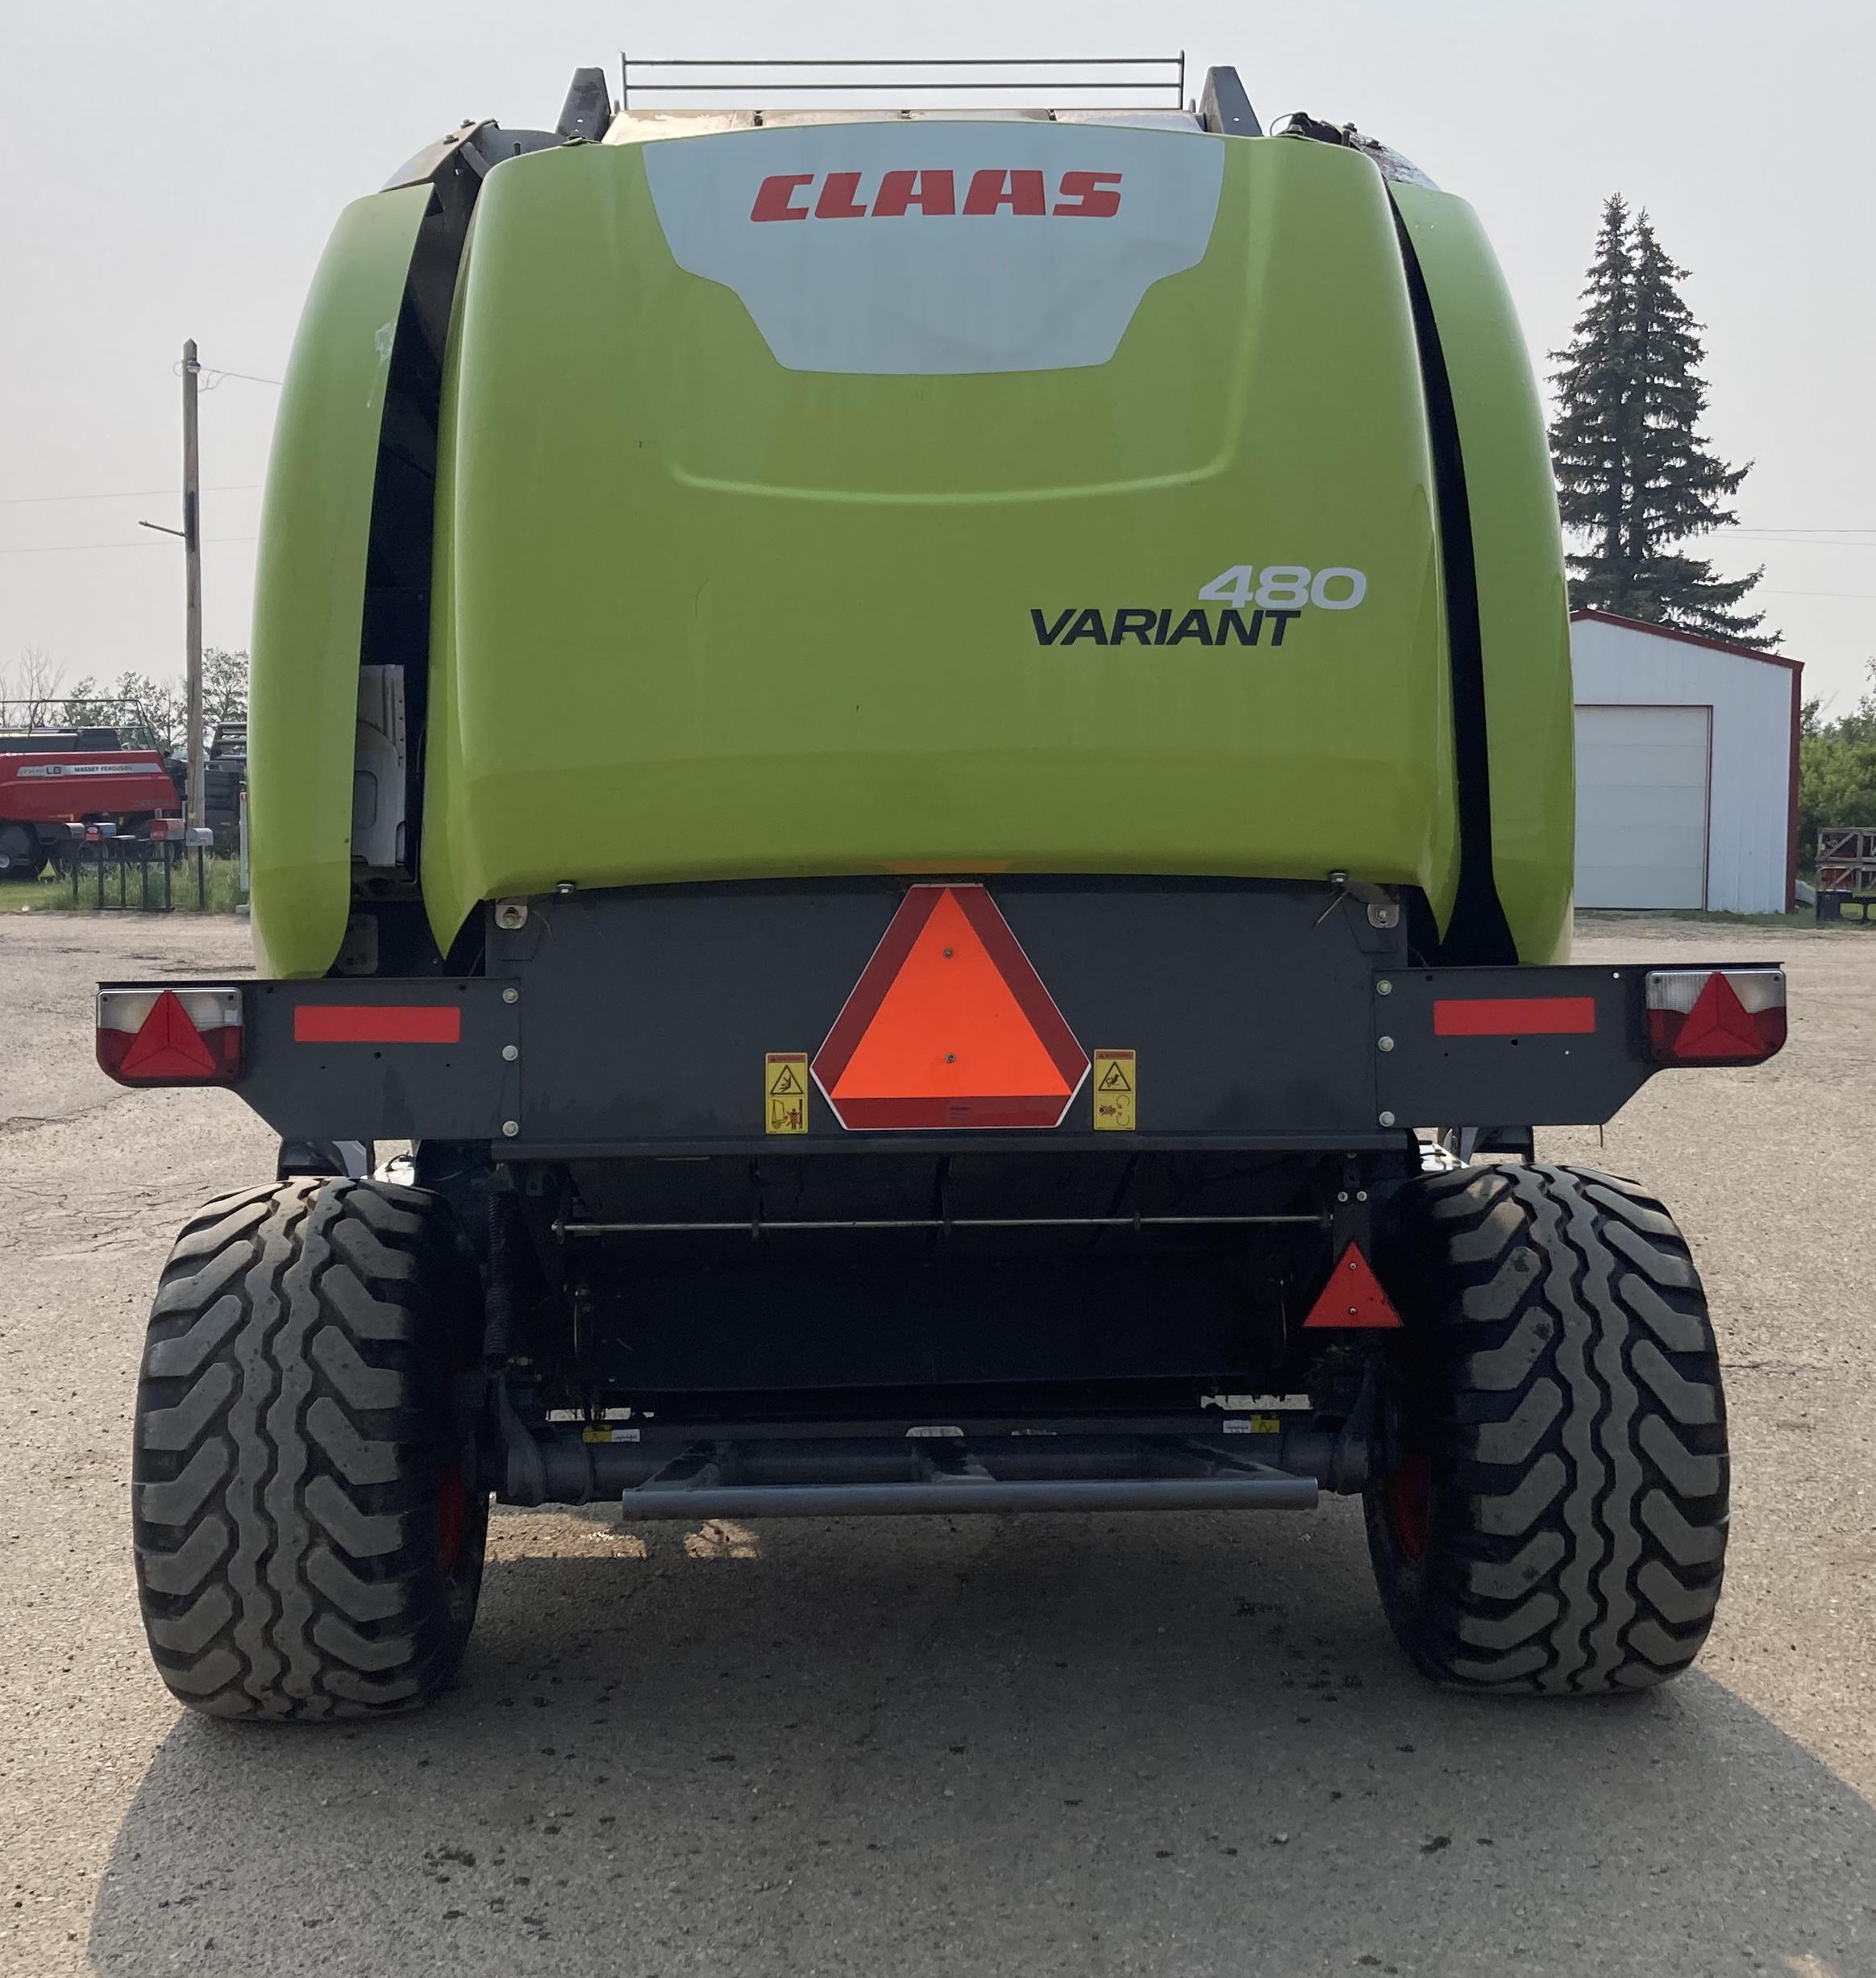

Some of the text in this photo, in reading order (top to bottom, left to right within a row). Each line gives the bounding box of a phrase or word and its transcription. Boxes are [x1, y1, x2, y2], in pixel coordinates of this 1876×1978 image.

[751, 169, 1123, 222] CLAAS
[1198, 565, 1366, 610] 480
[1030, 609, 1301, 646] VARIANT
